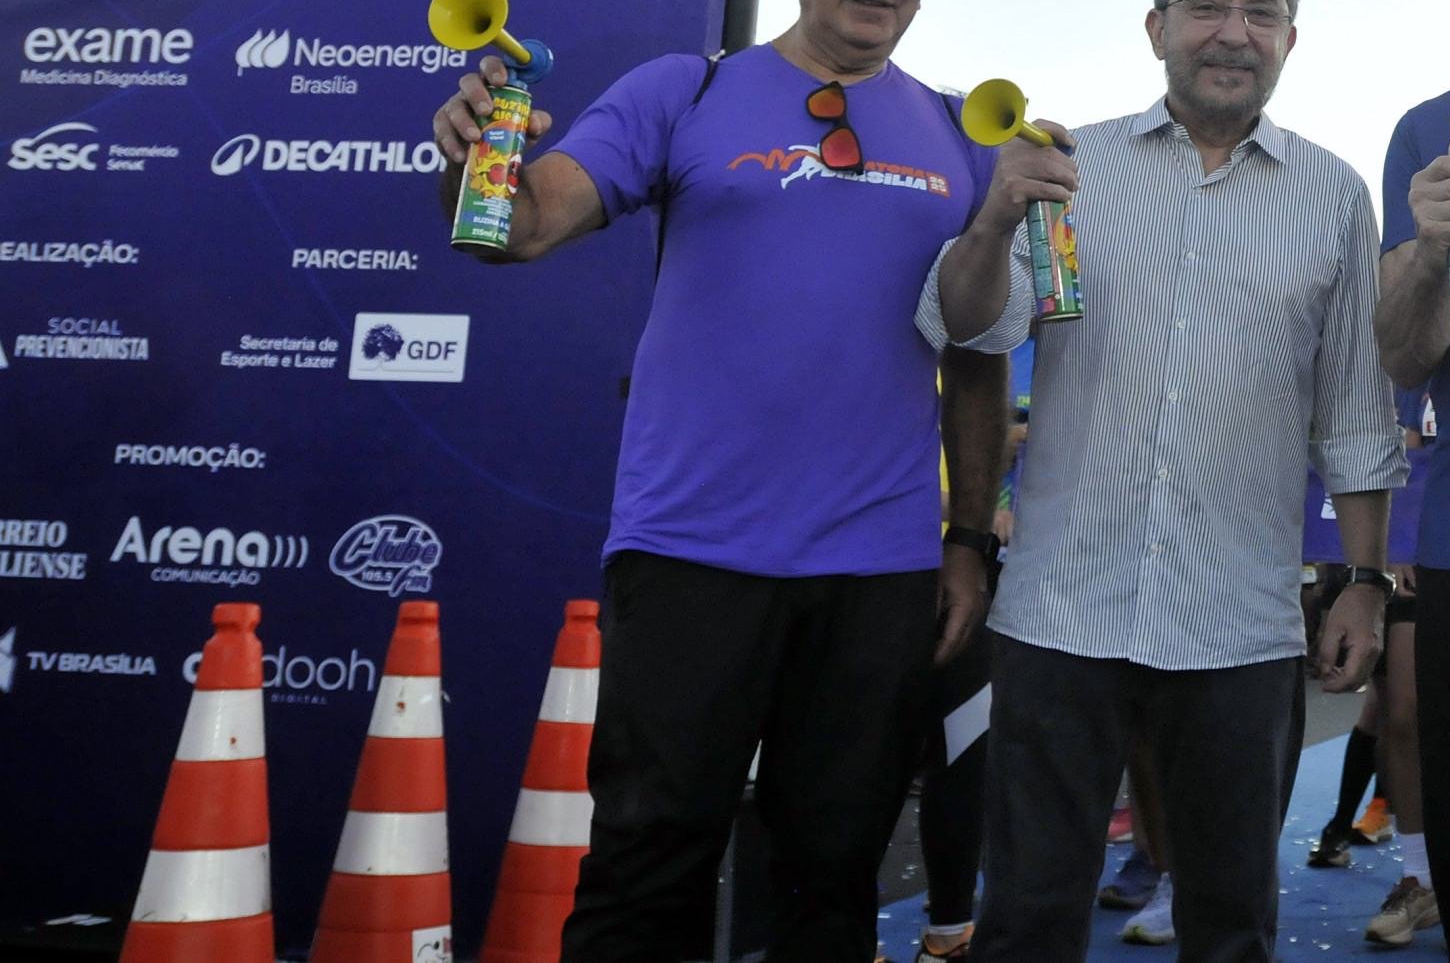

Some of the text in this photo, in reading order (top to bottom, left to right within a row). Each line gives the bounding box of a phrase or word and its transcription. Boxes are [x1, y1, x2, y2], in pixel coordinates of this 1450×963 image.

[24, 27, 194, 64] exame
[294, 38, 468, 73] Neoenergia
[20, 69, 188, 88] Medicina Diagnóstica
[290, 75, 358, 94] Brasília
[292, 249, 418, 270] PARCERIA:
[48, 317, 122, 335] SOCIAL
[14, 335, 149, 360] PREVENCIONISTA
[240, 335, 339, 352] Secretaria de
[407, 341, 458, 360] GDF
[221, 351, 337, 368] Esporte e Lazer
[114, 443, 266, 473] PROMOÇÃO:
[110, 515, 270, 568] Arena
[151, 567, 260, 587] COMUNICAÇÃO
[27, 652, 156, 675] TV BRASÍLIA
